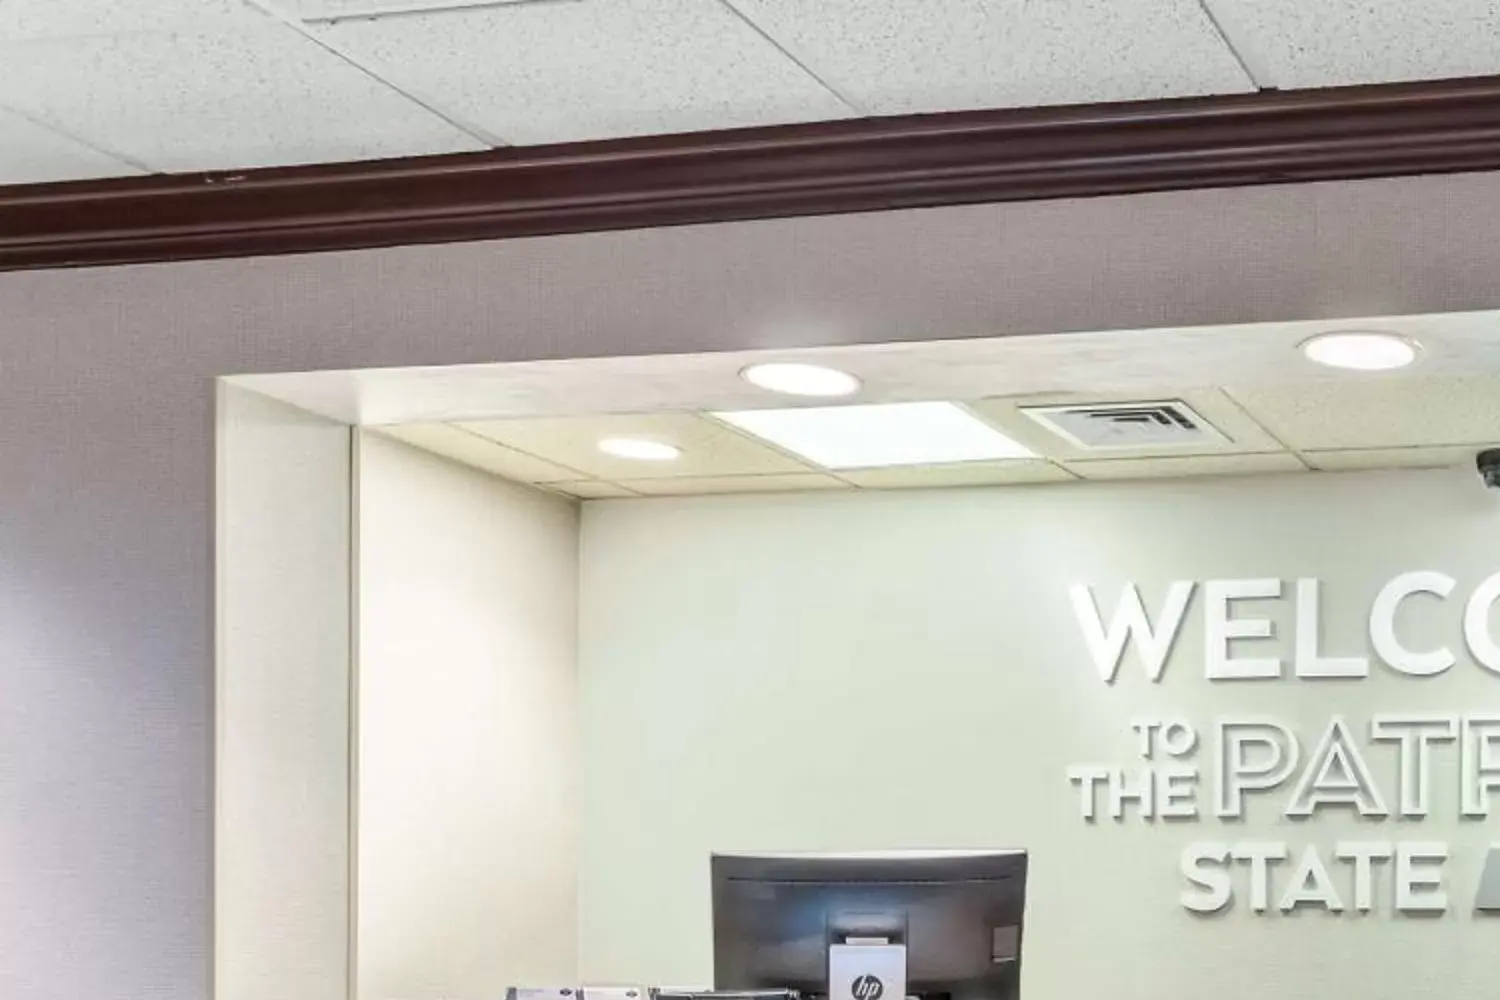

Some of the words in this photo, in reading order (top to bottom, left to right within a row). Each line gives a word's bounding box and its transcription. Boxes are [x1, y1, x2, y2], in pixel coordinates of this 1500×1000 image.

[1132, 720, 1198, 759] TO
[1067, 766, 1198, 820] THE
[1179, 840, 1449, 911] STATE
